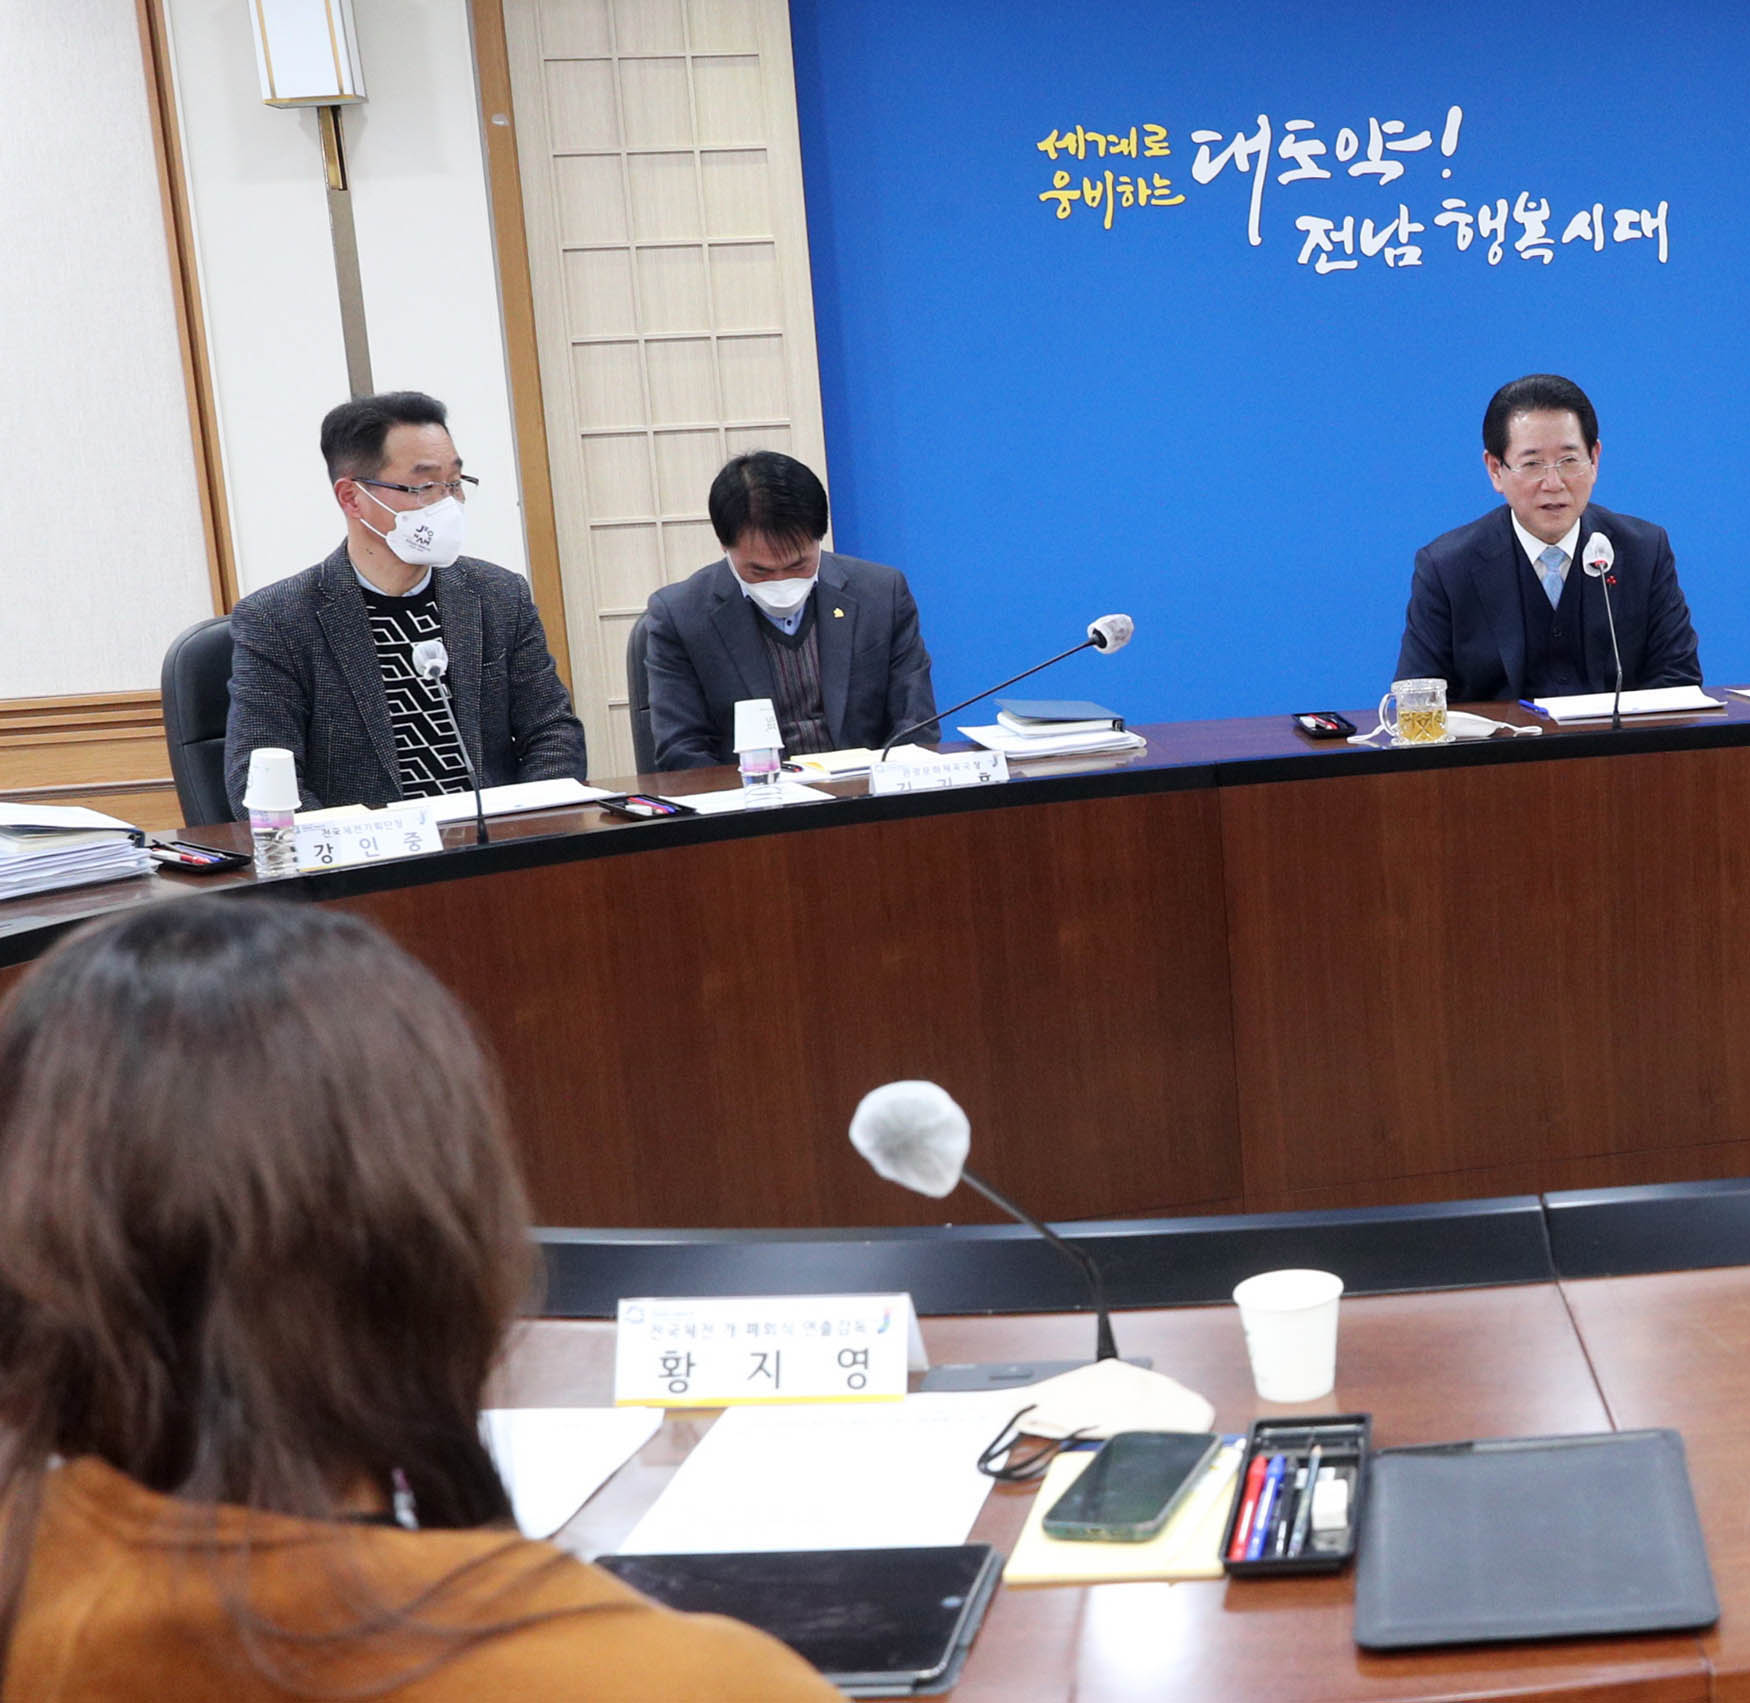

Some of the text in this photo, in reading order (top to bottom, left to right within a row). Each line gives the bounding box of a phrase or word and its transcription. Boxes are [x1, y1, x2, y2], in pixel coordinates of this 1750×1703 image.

[1037, 124, 1171, 159] 세계로
[1038, 170, 1186, 229] 웅비하는
[1190, 105, 1464, 246] 대도약!
[1294, 205, 1425, 274] 전남
[314, 831, 423, 864] 강 인 중
[658, 1347, 869, 1394] 황 지 영
